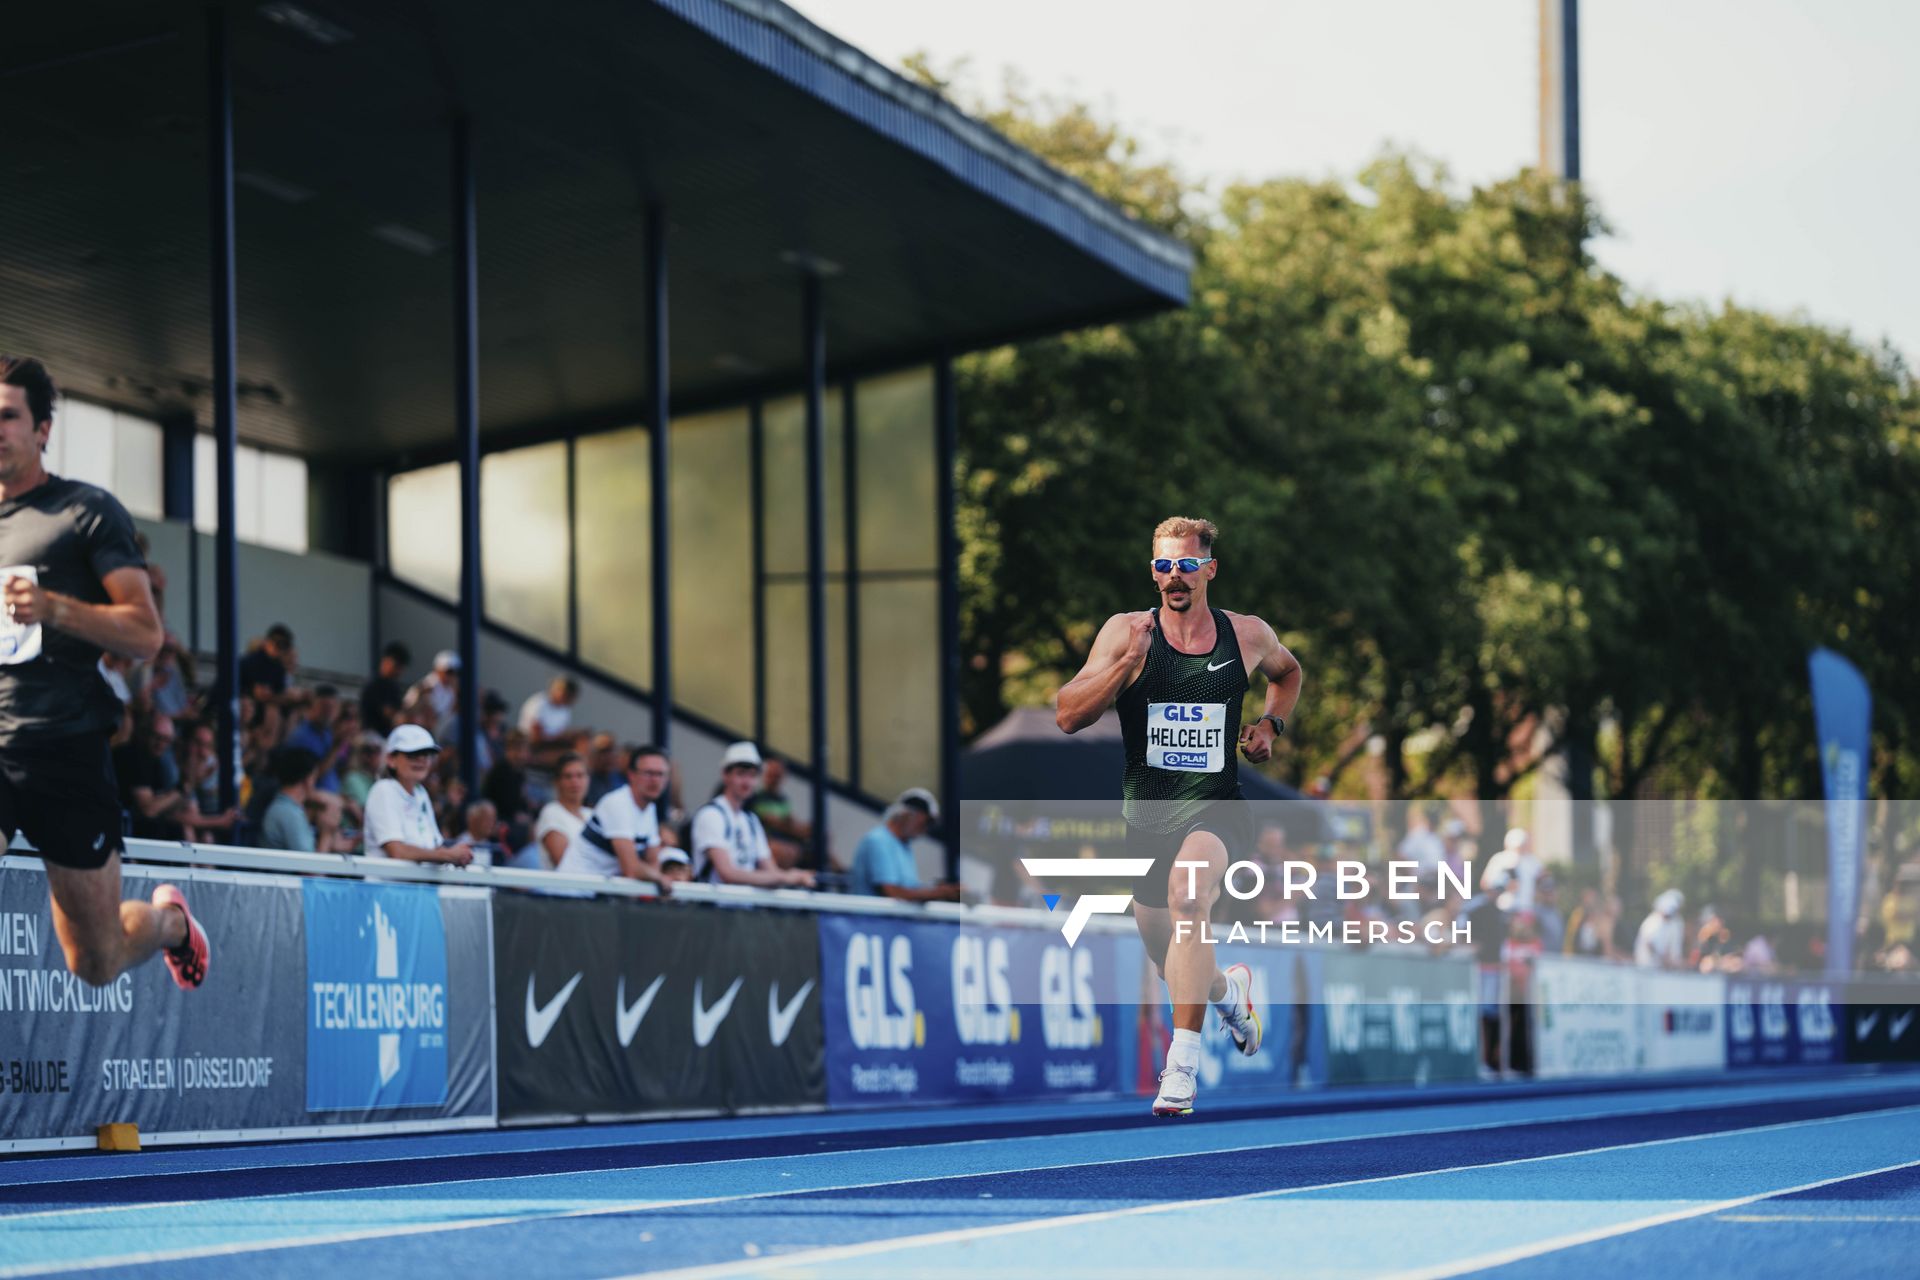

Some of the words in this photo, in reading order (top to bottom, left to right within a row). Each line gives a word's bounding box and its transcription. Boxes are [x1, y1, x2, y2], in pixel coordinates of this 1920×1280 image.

[1151, 727, 1221, 748] HELCELET
[1181, 755, 1206, 763] PLAN
[313, 982, 443, 1029] TECKLENBURG
